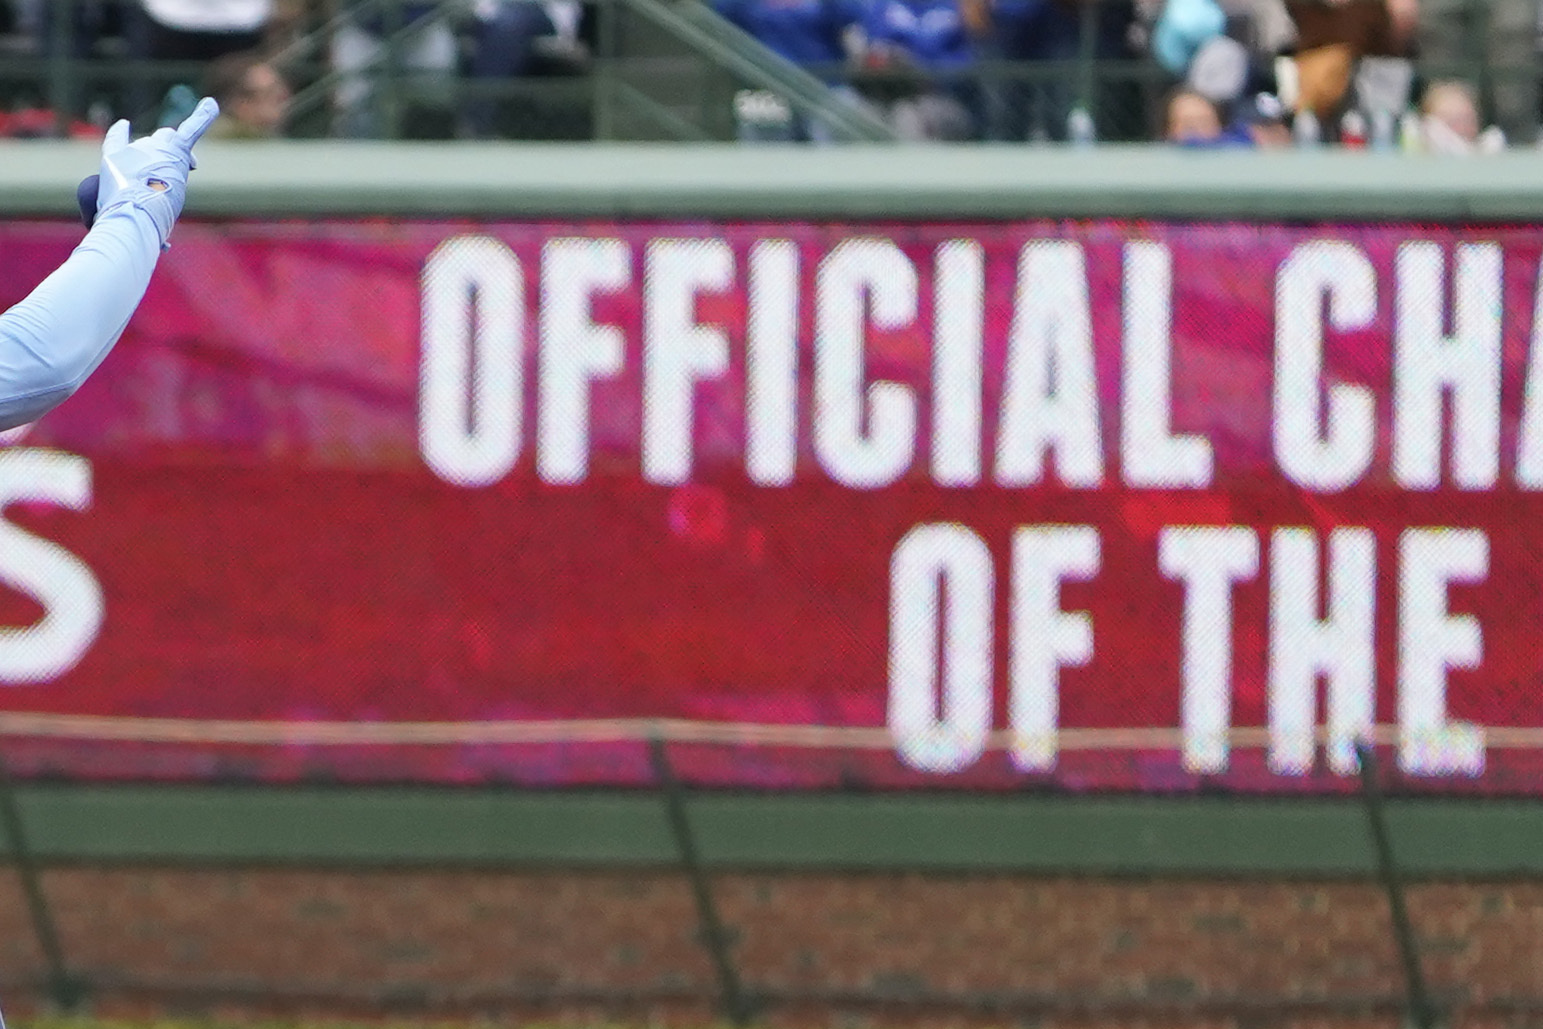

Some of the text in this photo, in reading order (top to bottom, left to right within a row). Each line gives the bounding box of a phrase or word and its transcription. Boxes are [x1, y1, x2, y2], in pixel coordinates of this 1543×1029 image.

[419, 236, 1215, 489] OFFICIAL
[888, 522, 1490, 776] OF THE
